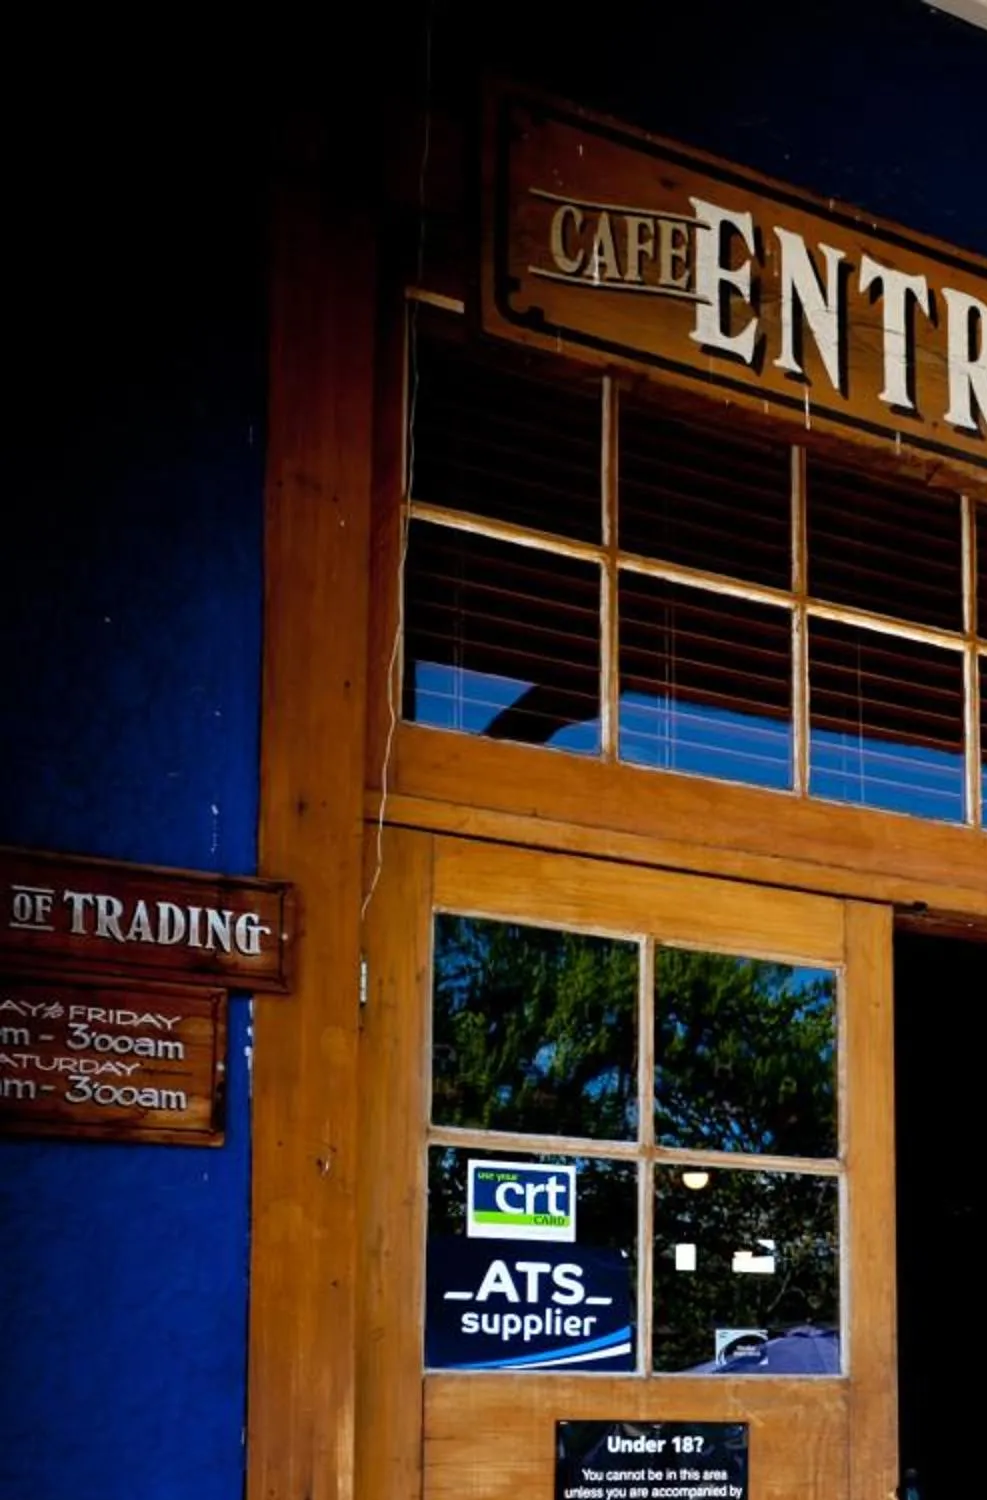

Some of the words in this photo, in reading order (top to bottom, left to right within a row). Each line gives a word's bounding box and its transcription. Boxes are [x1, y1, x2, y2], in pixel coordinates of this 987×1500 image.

[550, 204, 690, 289] CAFE
[12, 892, 53, 923] OF
[64, 890, 271, 954] TRADING
[69, 1005, 181, 1030] FRIDAY
[495, 1175, 566, 1216] crt
[533, 1216, 565, 1226] CARD
[461, 1309, 597, 1341] supplier
[607, 1435, 666, 1453] Under
[671, 1436, 704, 1453] 18?
[582, 1469, 602, 1481] You
[605, 1469, 645, 1481] cannot
[647, 1469, 663, 1481] be
[666, 1469, 677, 1481] in
[679, 1469, 700, 1481] this
[702, 1470, 728, 1481] area
[564, 1486, 604, 1499] unless
[606, 1488, 626, 1500] you
[629, 1487, 649, 1498] are
[651, 1485, 727, 1499] accompanied
[729, 1485, 742, 1499] by
